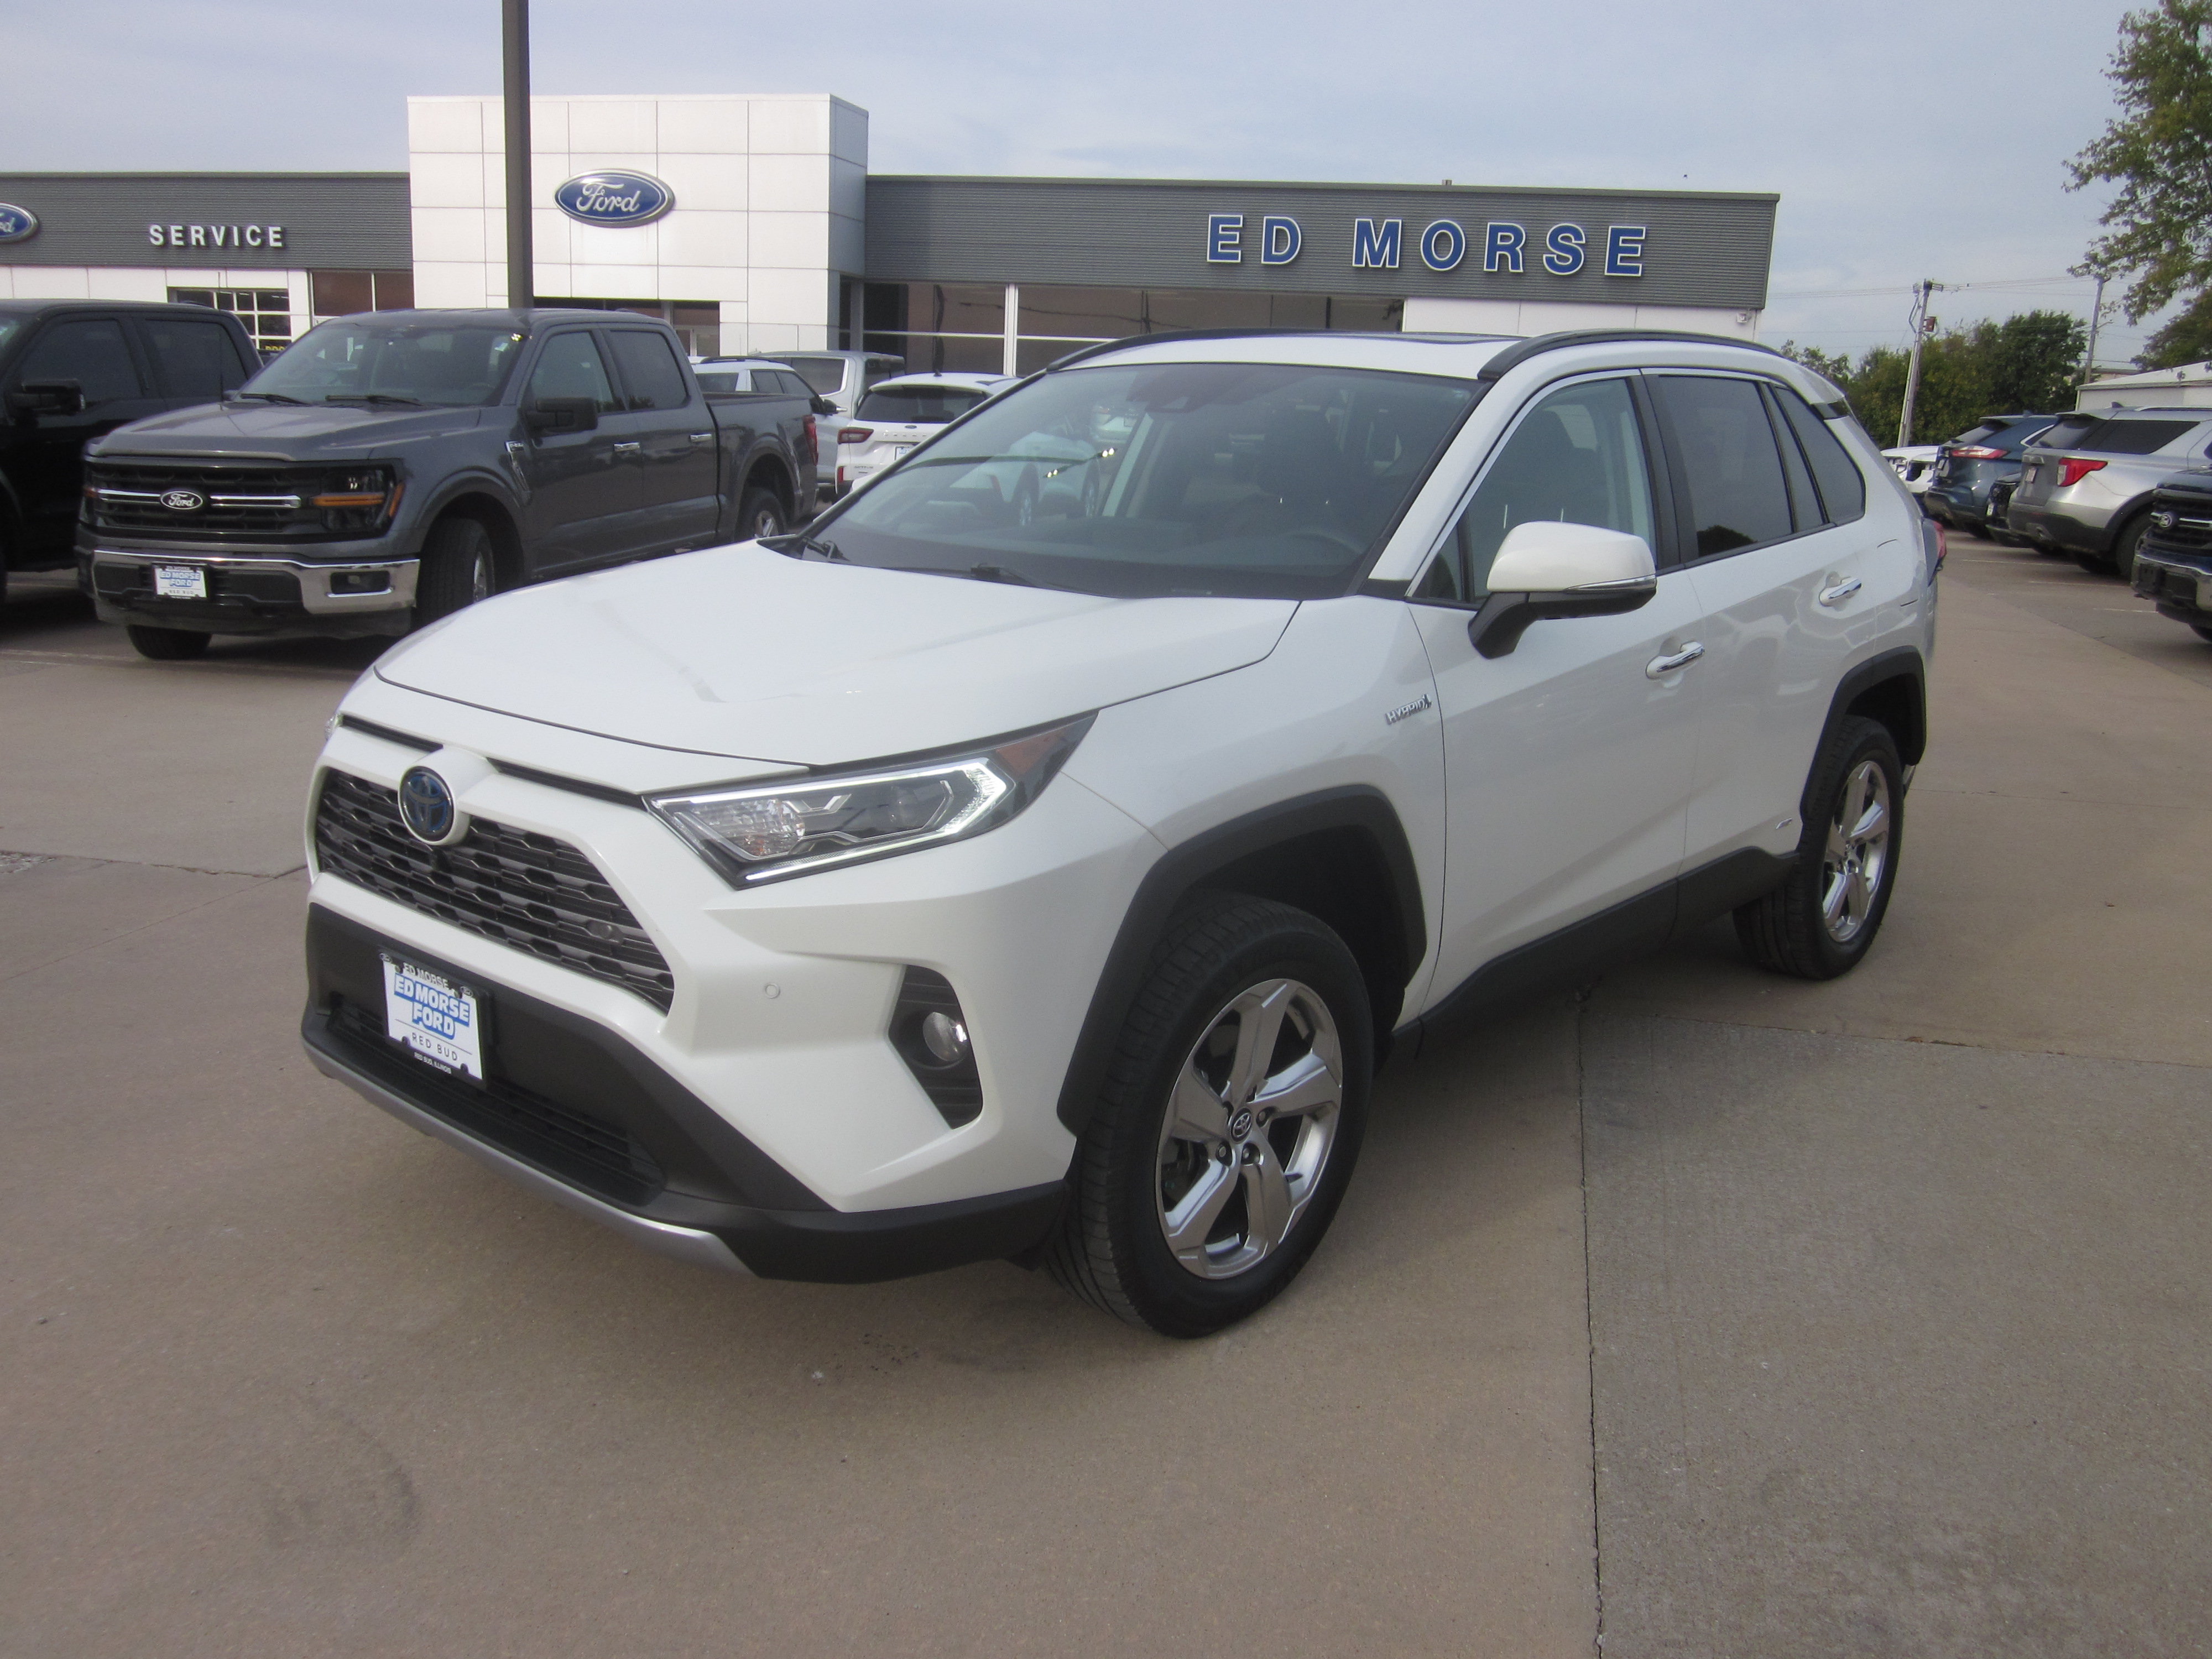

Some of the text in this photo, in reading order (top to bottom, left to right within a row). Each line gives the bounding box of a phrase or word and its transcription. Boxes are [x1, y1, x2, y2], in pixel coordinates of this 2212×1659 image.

[576, 181, 641, 212] Ford
[149, 225, 285, 248] SERVICE
[1207, 214, 1646, 276] ED MORSE
[168, 493, 195, 506] Ford
[403, 962, 449, 988] ED MORSE
[394, 973, 470, 1026] ED MORSE
[413, 1002, 455, 1040] FORD
[412, 1032, 457, 1061] RED BUD
